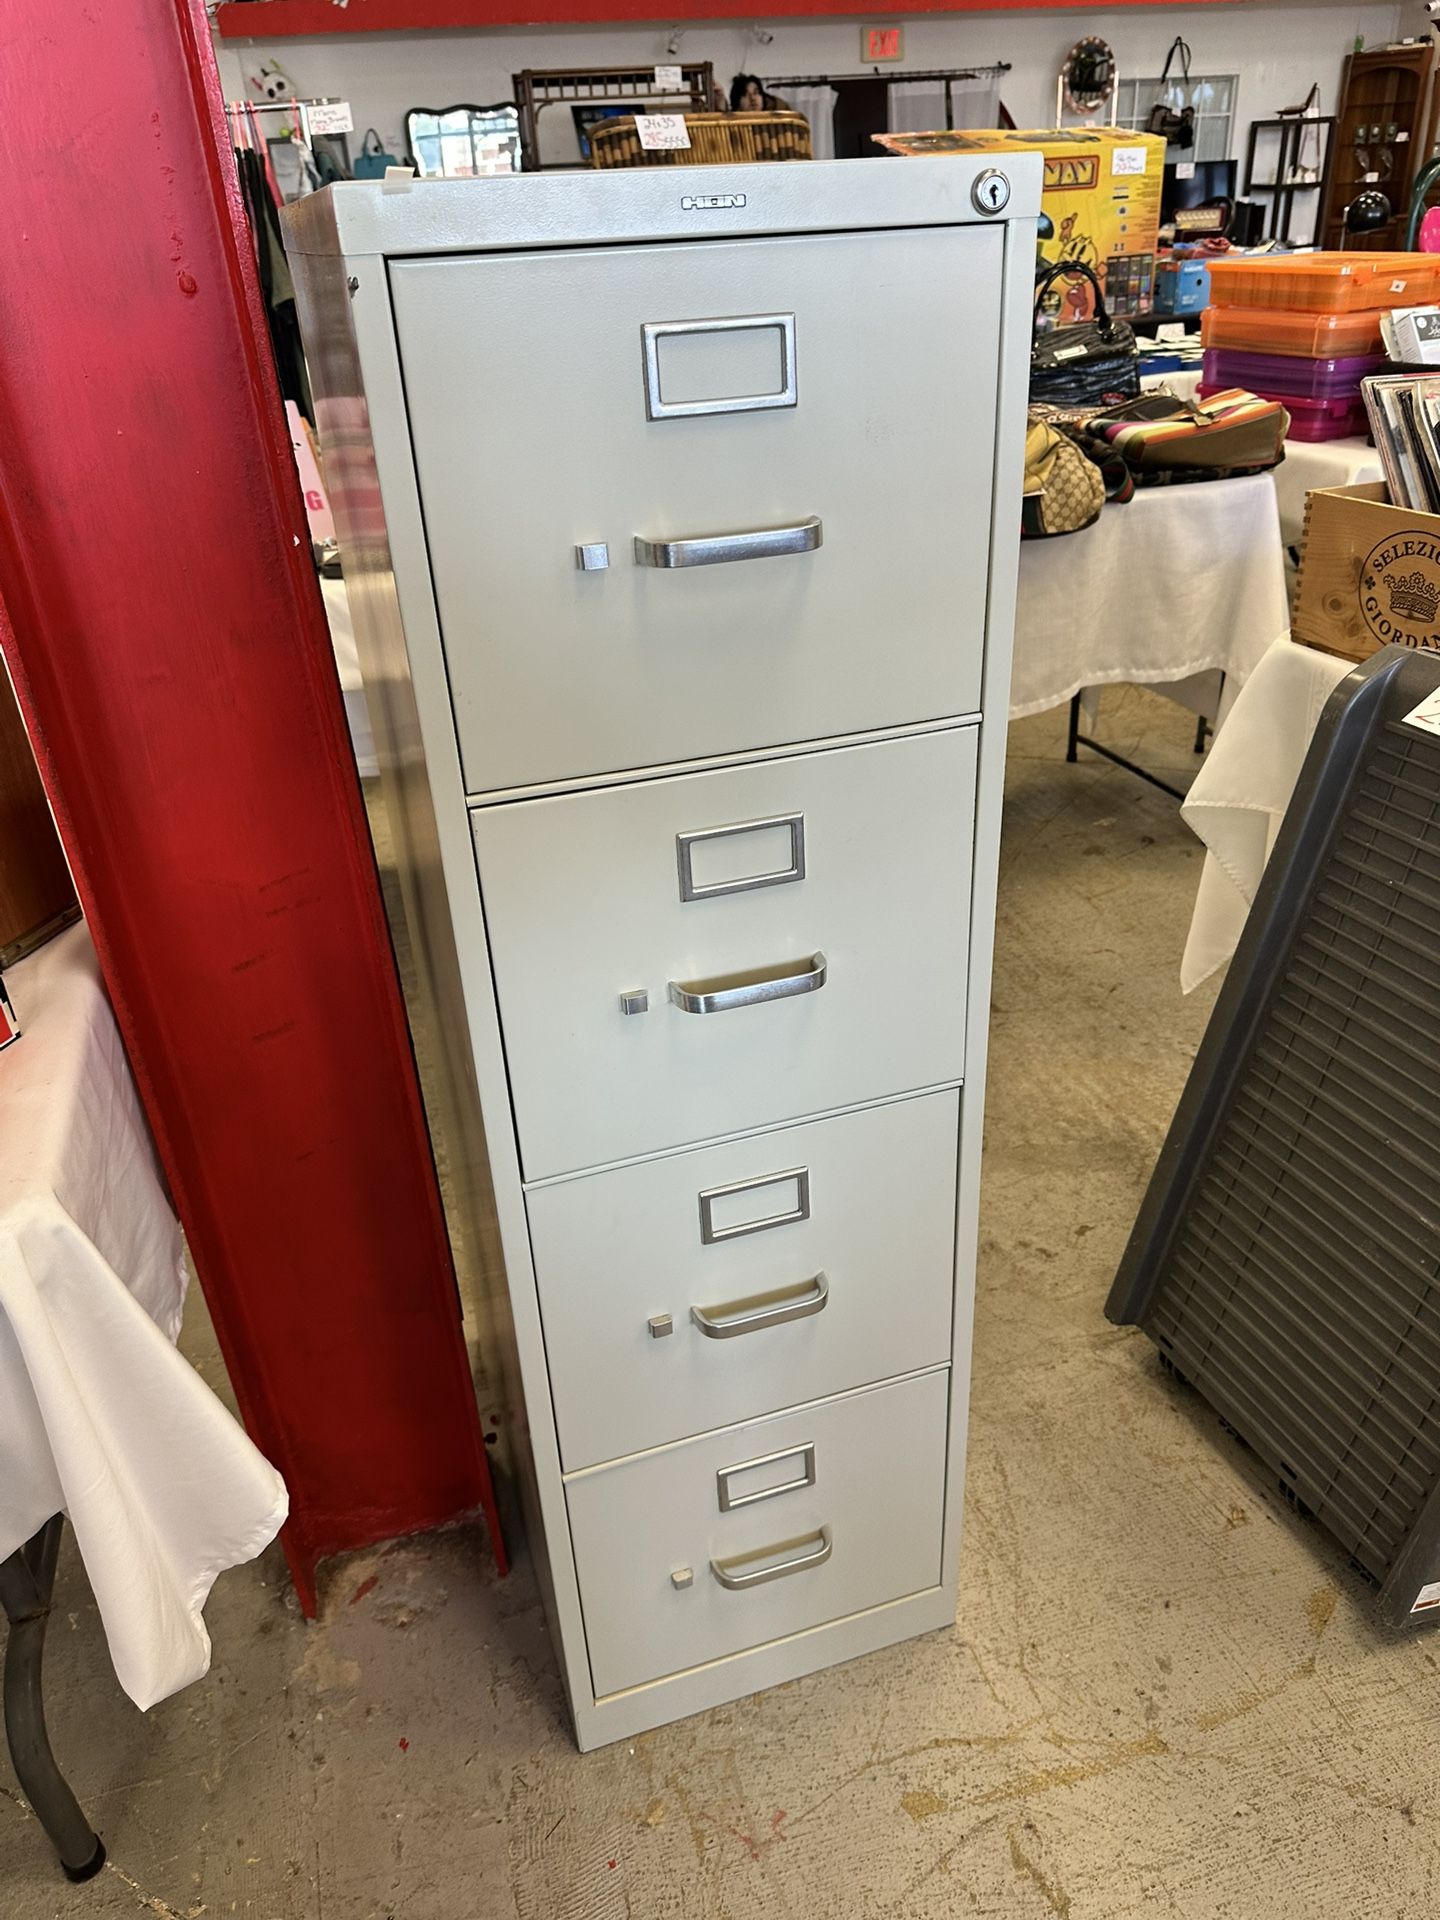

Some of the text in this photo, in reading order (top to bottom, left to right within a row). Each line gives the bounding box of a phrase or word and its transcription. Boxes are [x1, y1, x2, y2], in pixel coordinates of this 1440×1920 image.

[868, 30, 898, 57] EXIT
[1044, 160, 1095, 187] MAN
[681, 193, 746, 210] HON
